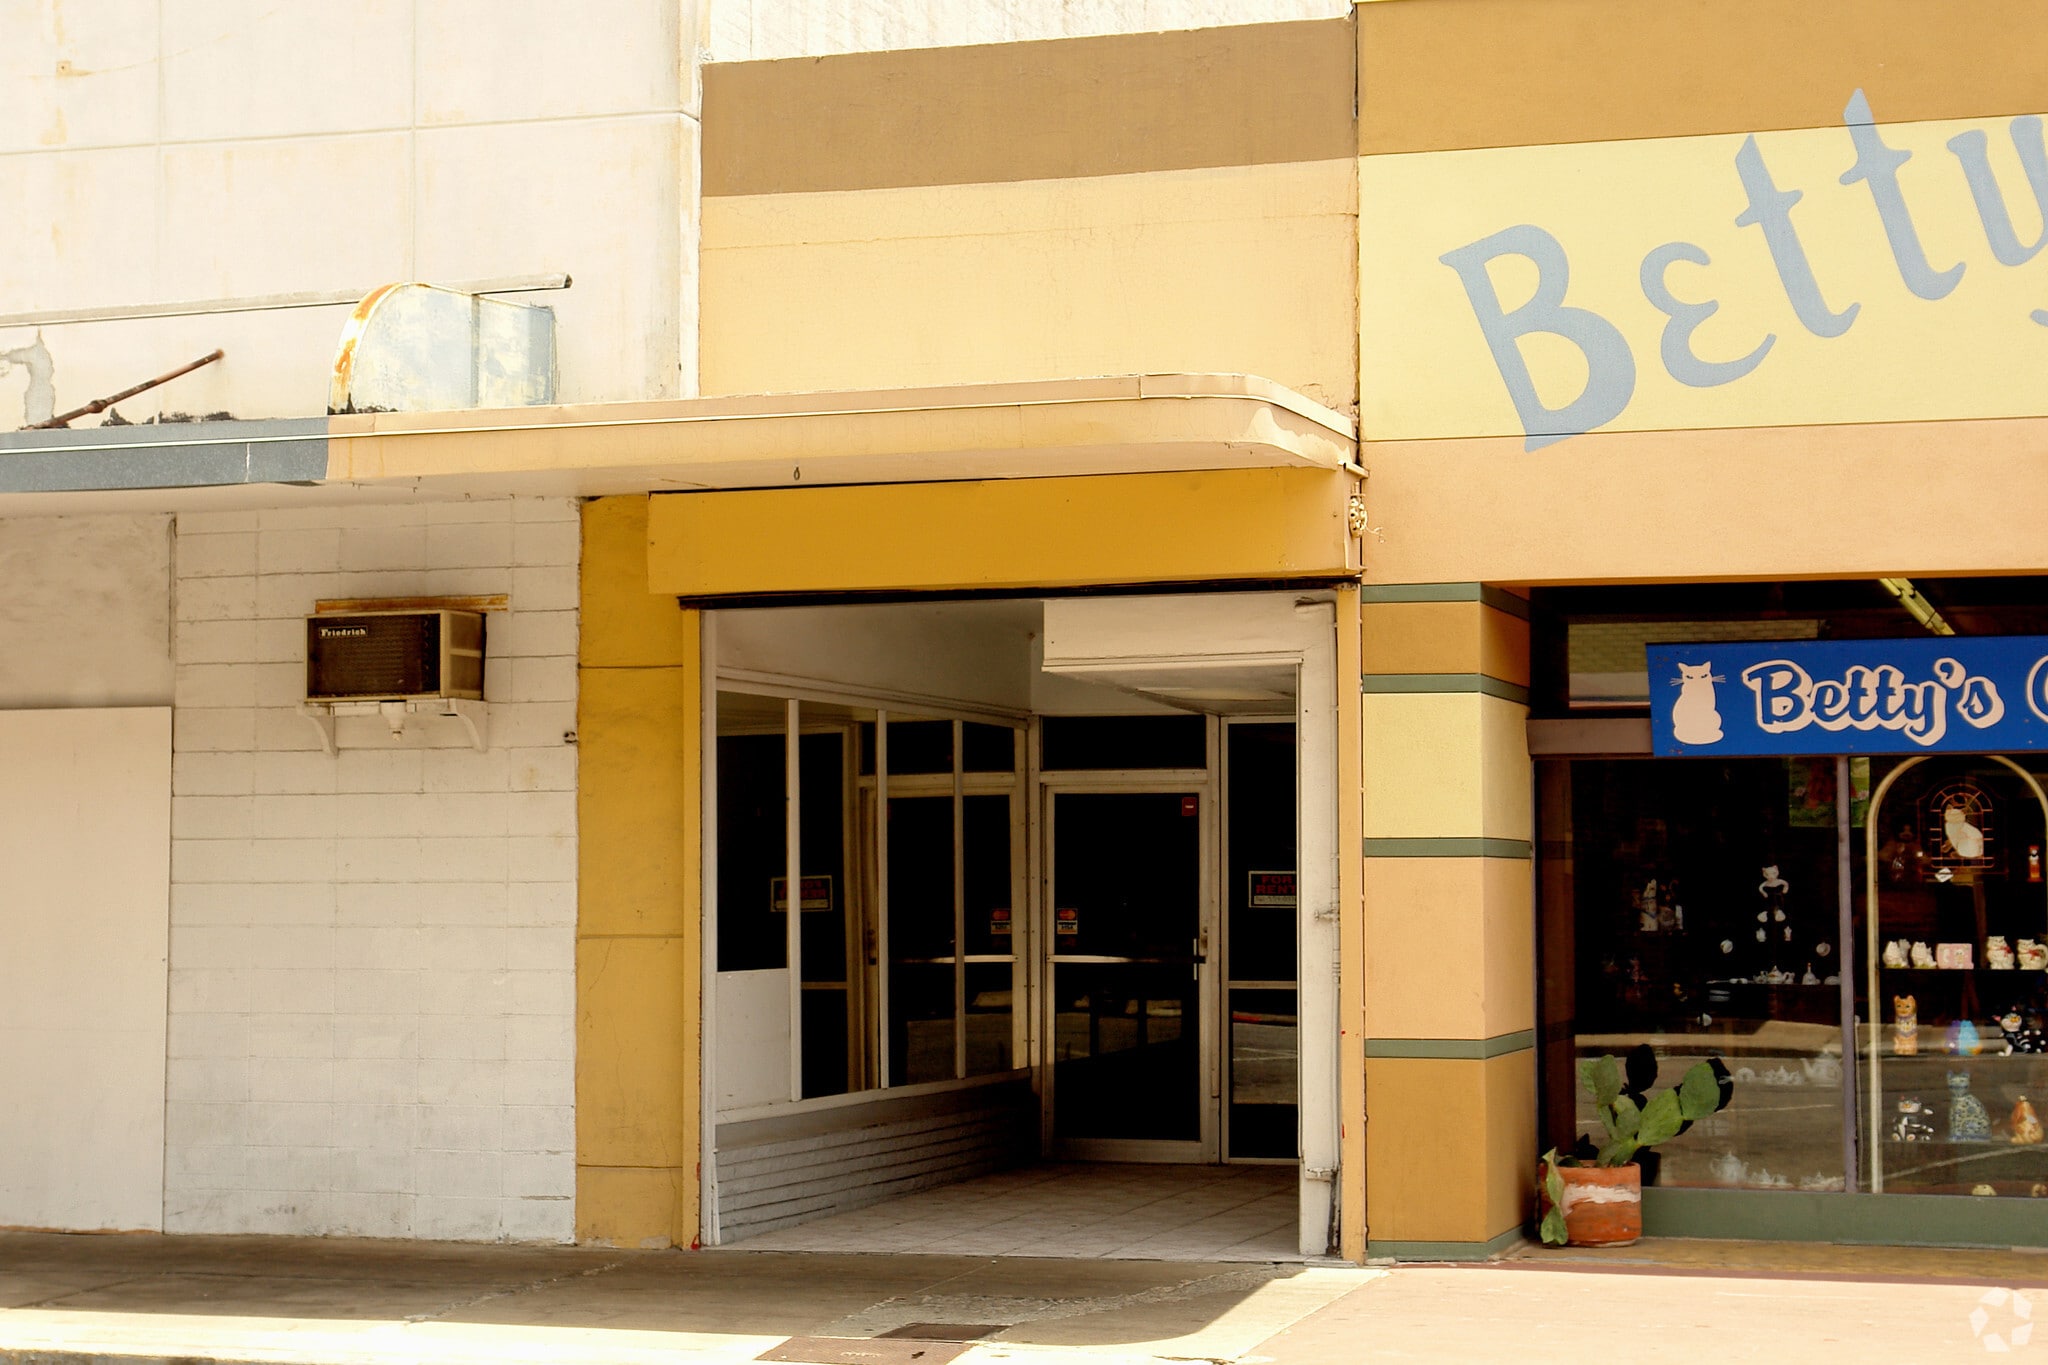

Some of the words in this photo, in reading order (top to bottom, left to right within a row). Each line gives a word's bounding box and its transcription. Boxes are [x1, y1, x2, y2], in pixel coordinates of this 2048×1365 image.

[321, 628, 366, 637] Friedrich
[1742, 657, 2005, 746] Betty's
[1261, 875, 1293, 884] FOR
